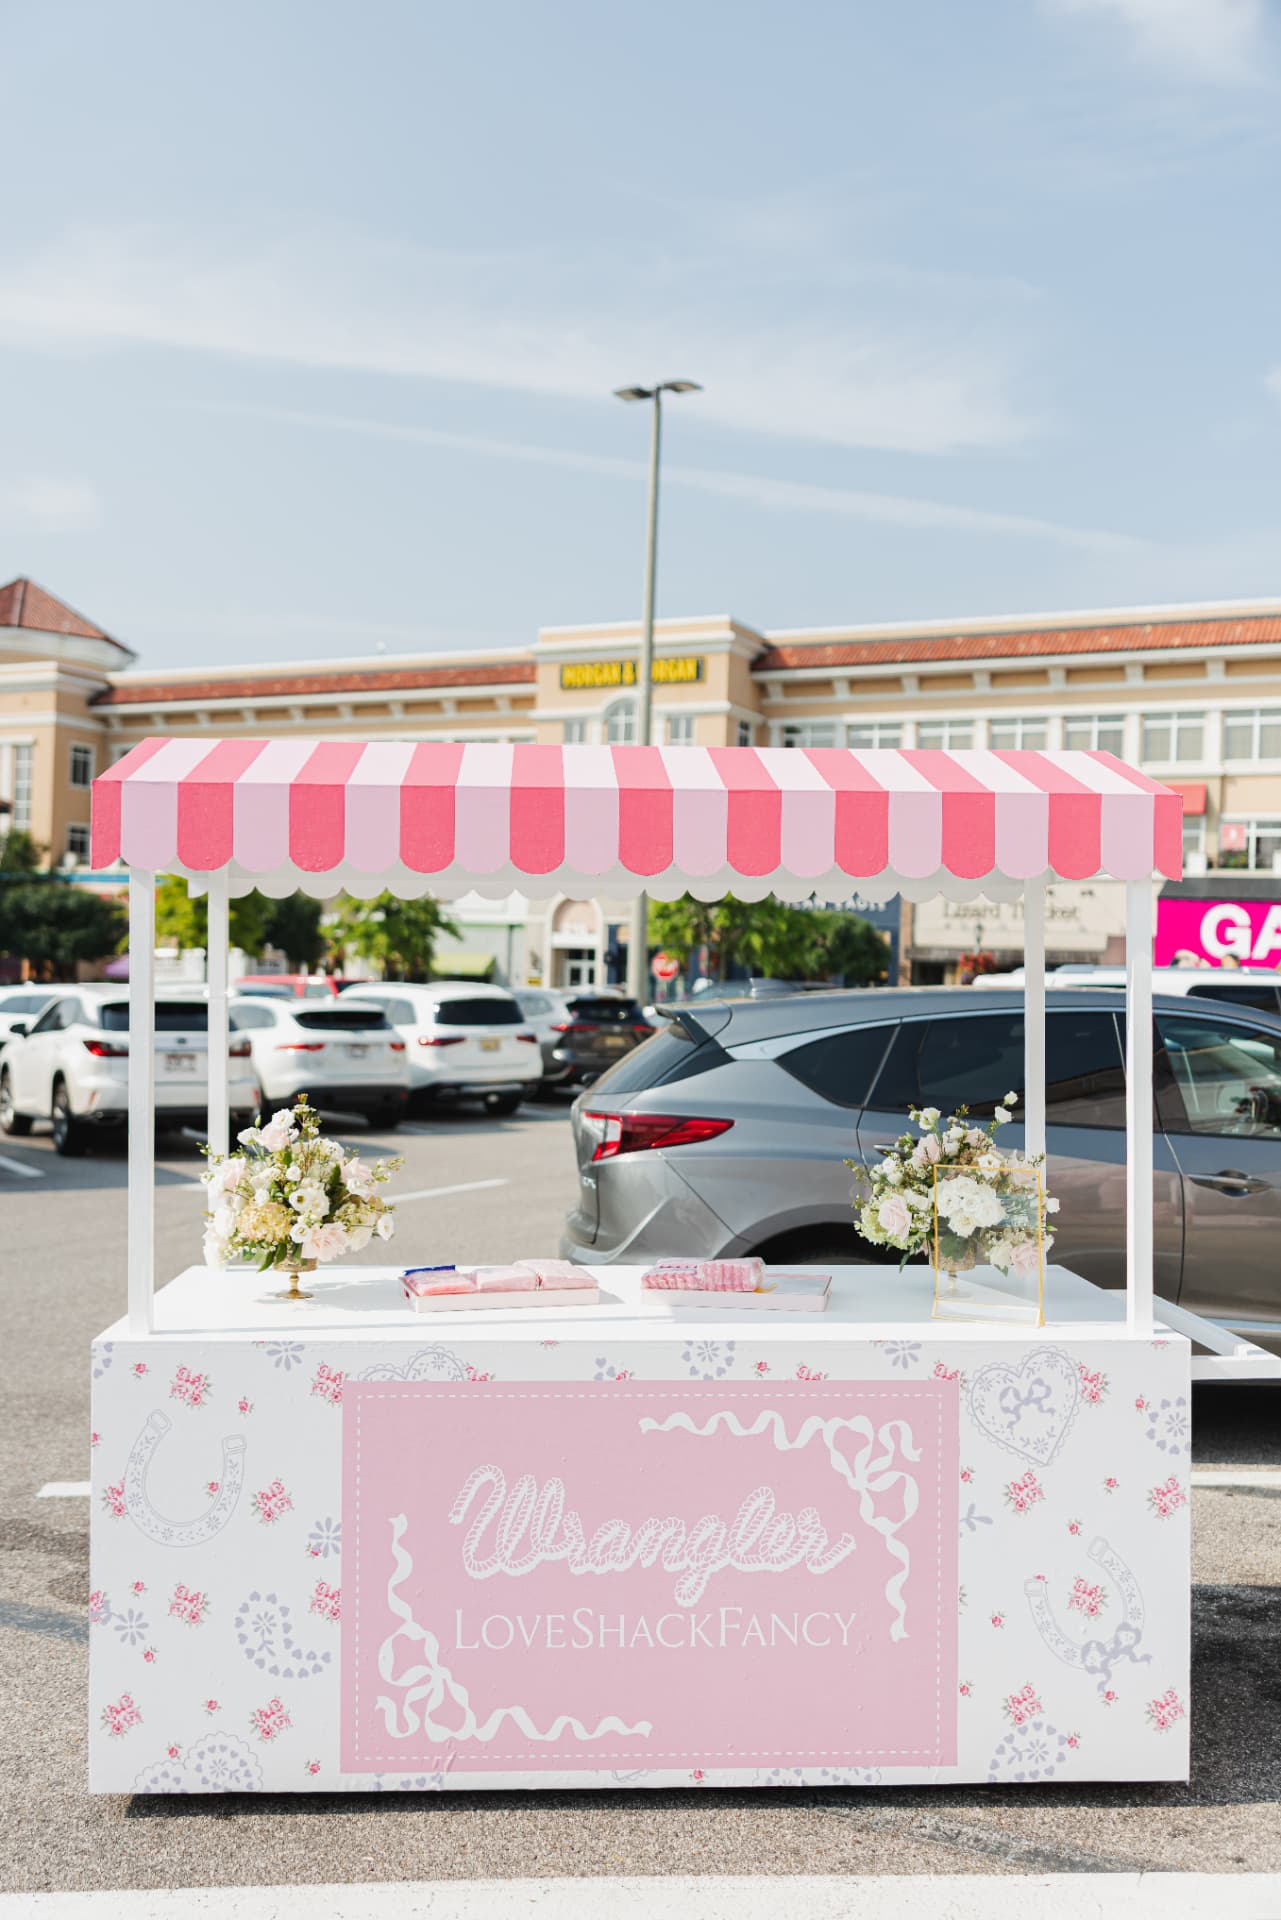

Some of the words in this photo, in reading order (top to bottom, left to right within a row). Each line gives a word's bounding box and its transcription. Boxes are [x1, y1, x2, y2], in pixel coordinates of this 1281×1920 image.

[563, 663, 621, 687] MORGAN
[622, 661, 635, 685] &
[649, 657, 698, 682] ORGAN
[448, 1463, 857, 1607] Wrangler
